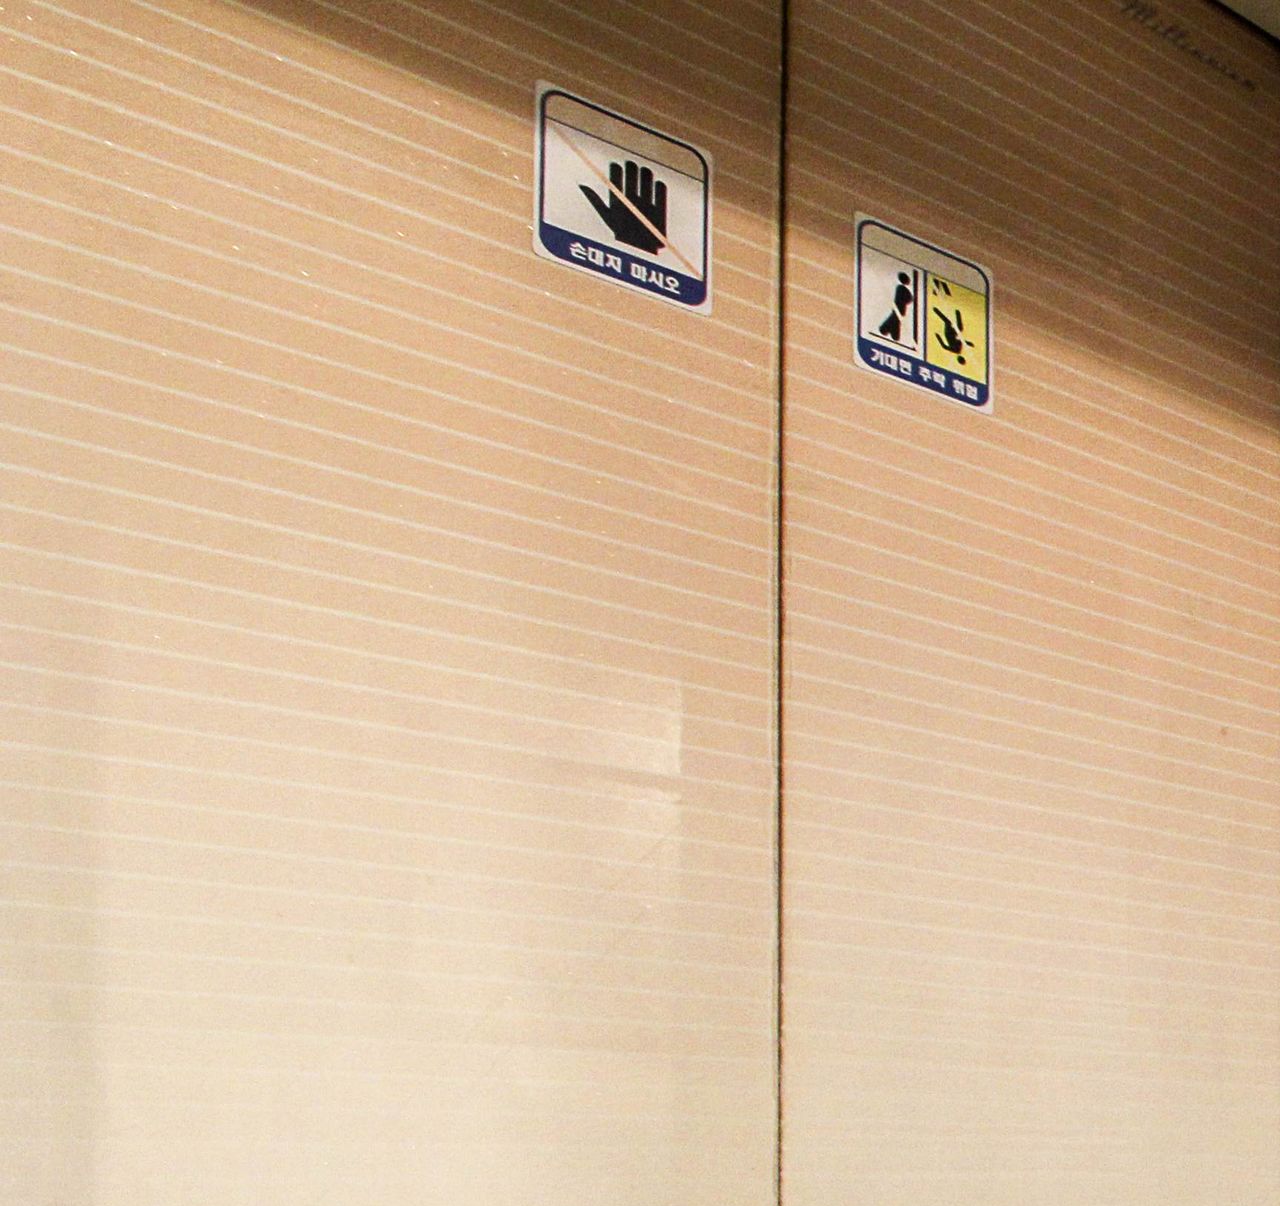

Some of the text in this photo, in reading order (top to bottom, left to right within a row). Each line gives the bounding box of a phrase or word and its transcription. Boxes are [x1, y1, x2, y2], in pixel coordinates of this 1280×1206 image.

[569, 241, 681, 295] 손대지 마시오
[870, 348, 979, 401] 기대면 추락 위험
